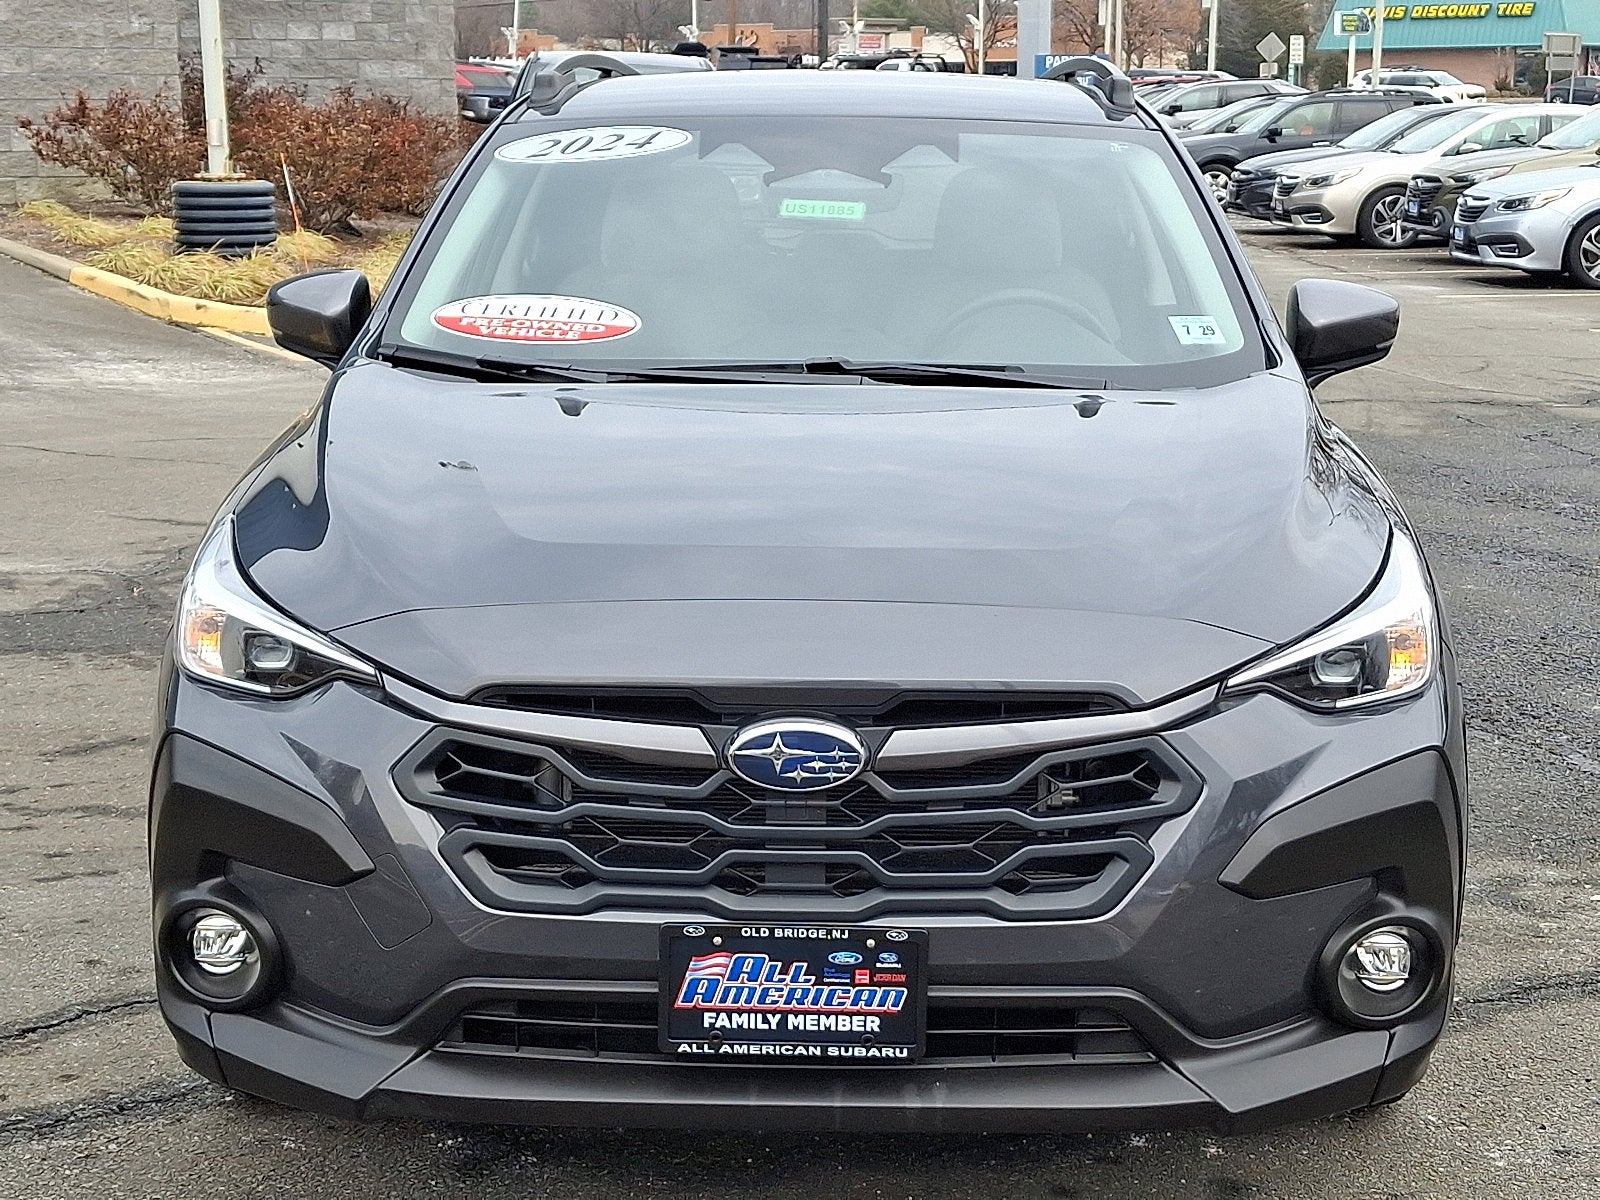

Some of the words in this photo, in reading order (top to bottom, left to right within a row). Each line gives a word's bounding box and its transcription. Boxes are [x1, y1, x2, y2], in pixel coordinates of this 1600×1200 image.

[1410, 4, 1491, 19] DISCOUNT
[1496, 2, 1536, 18] TIRE
[525, 130, 663, 159] 2024
[785, 203, 855, 216] US11885
[459, 316, 606, 333] PRE-OWNED
[478, 325, 583, 340] VEHICLE
[1181, 324, 1190, 335] 7
[1198, 324, 1216, 336] 29
[740, 927, 770, 938] OLD
[675, 975, 908, 1012] AMERICAN
[703, 1012, 782, 1030] FAMILY
[787, 1014, 881, 1032] MEMBER
[677, 1043, 715, 1053] ALL
[719, 1044, 824, 1056] AMERICAN
[827, 1046, 908, 1058] SUBARU
